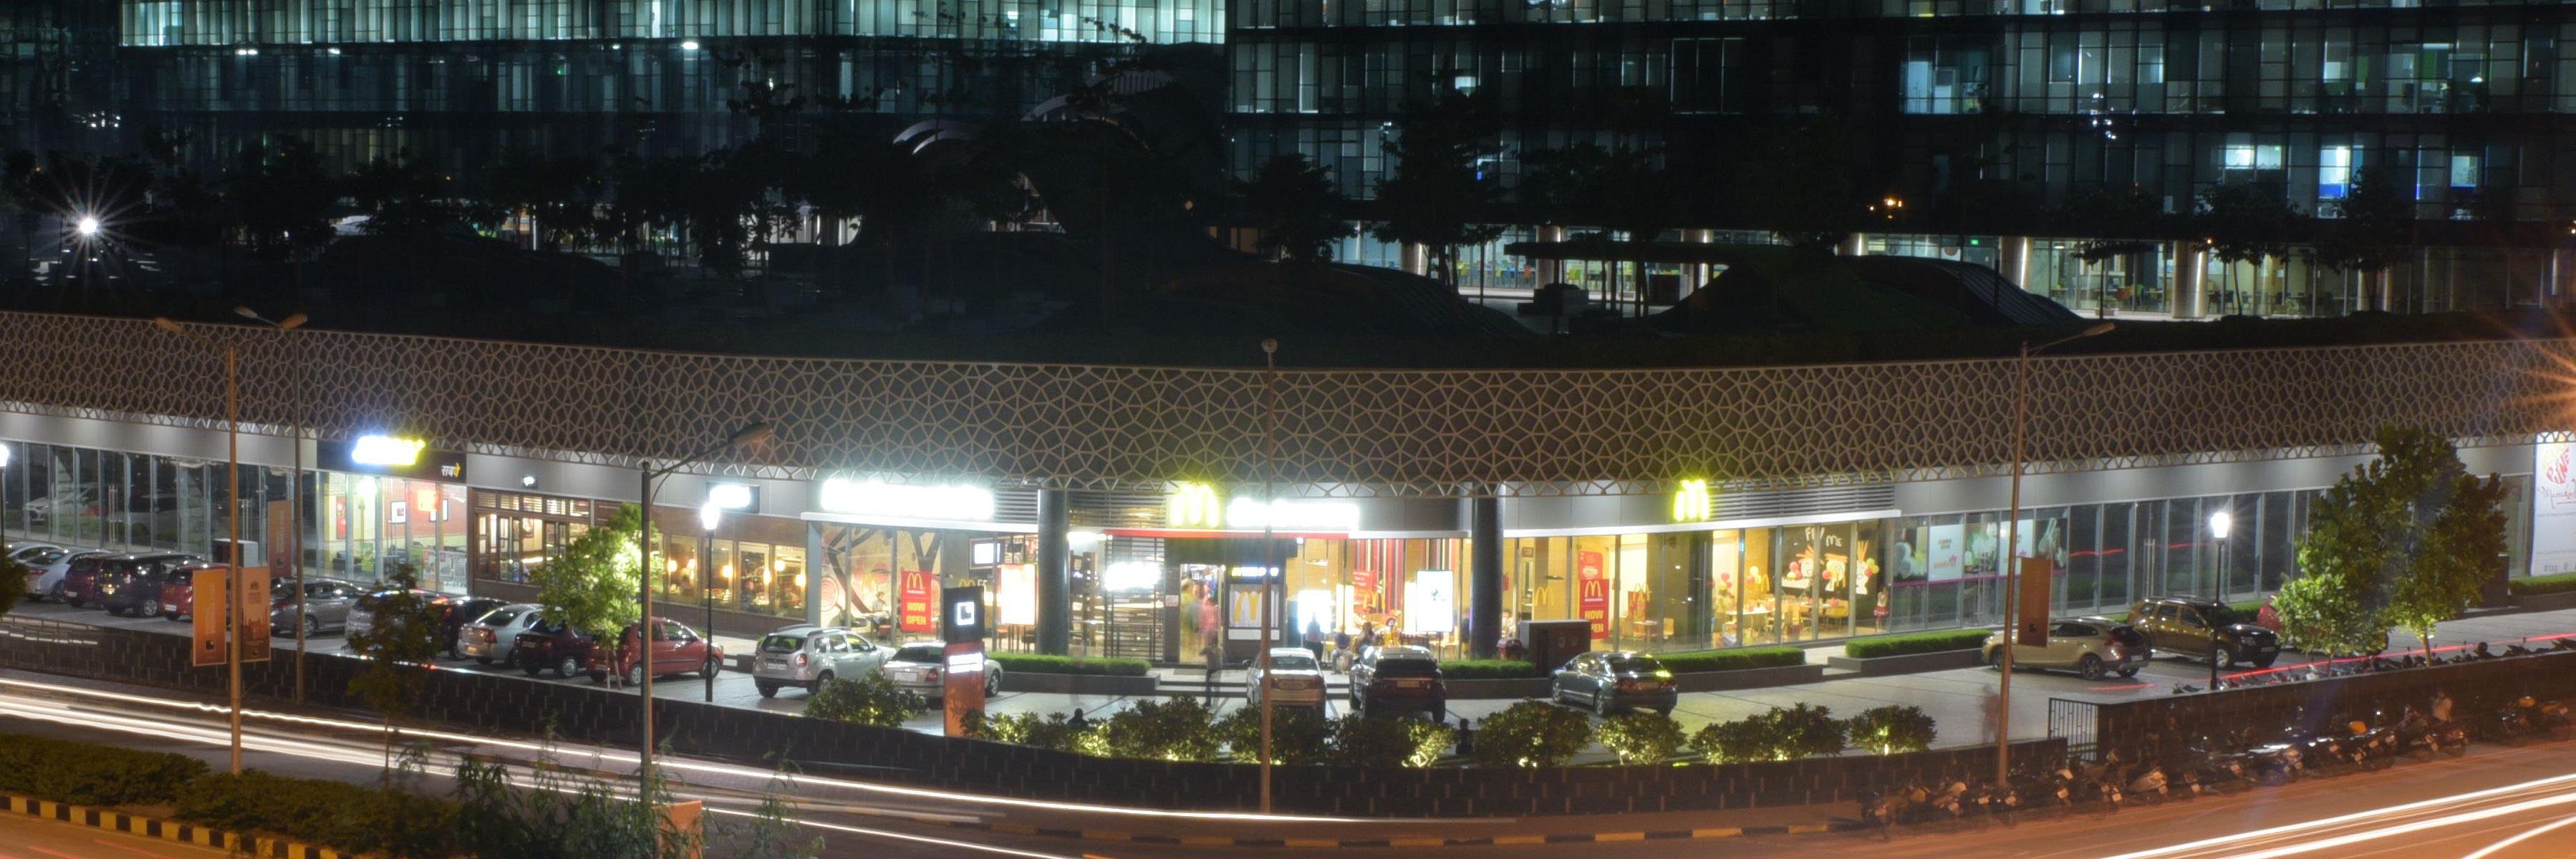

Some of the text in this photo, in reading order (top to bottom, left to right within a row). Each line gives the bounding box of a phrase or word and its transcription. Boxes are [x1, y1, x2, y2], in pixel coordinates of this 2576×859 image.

[441, 462, 460, 477] सबवे
[907, 602, 925, 611] NOW
[1585, 610, 1603, 619] NOW
[906, 615, 927, 625] OPEN
